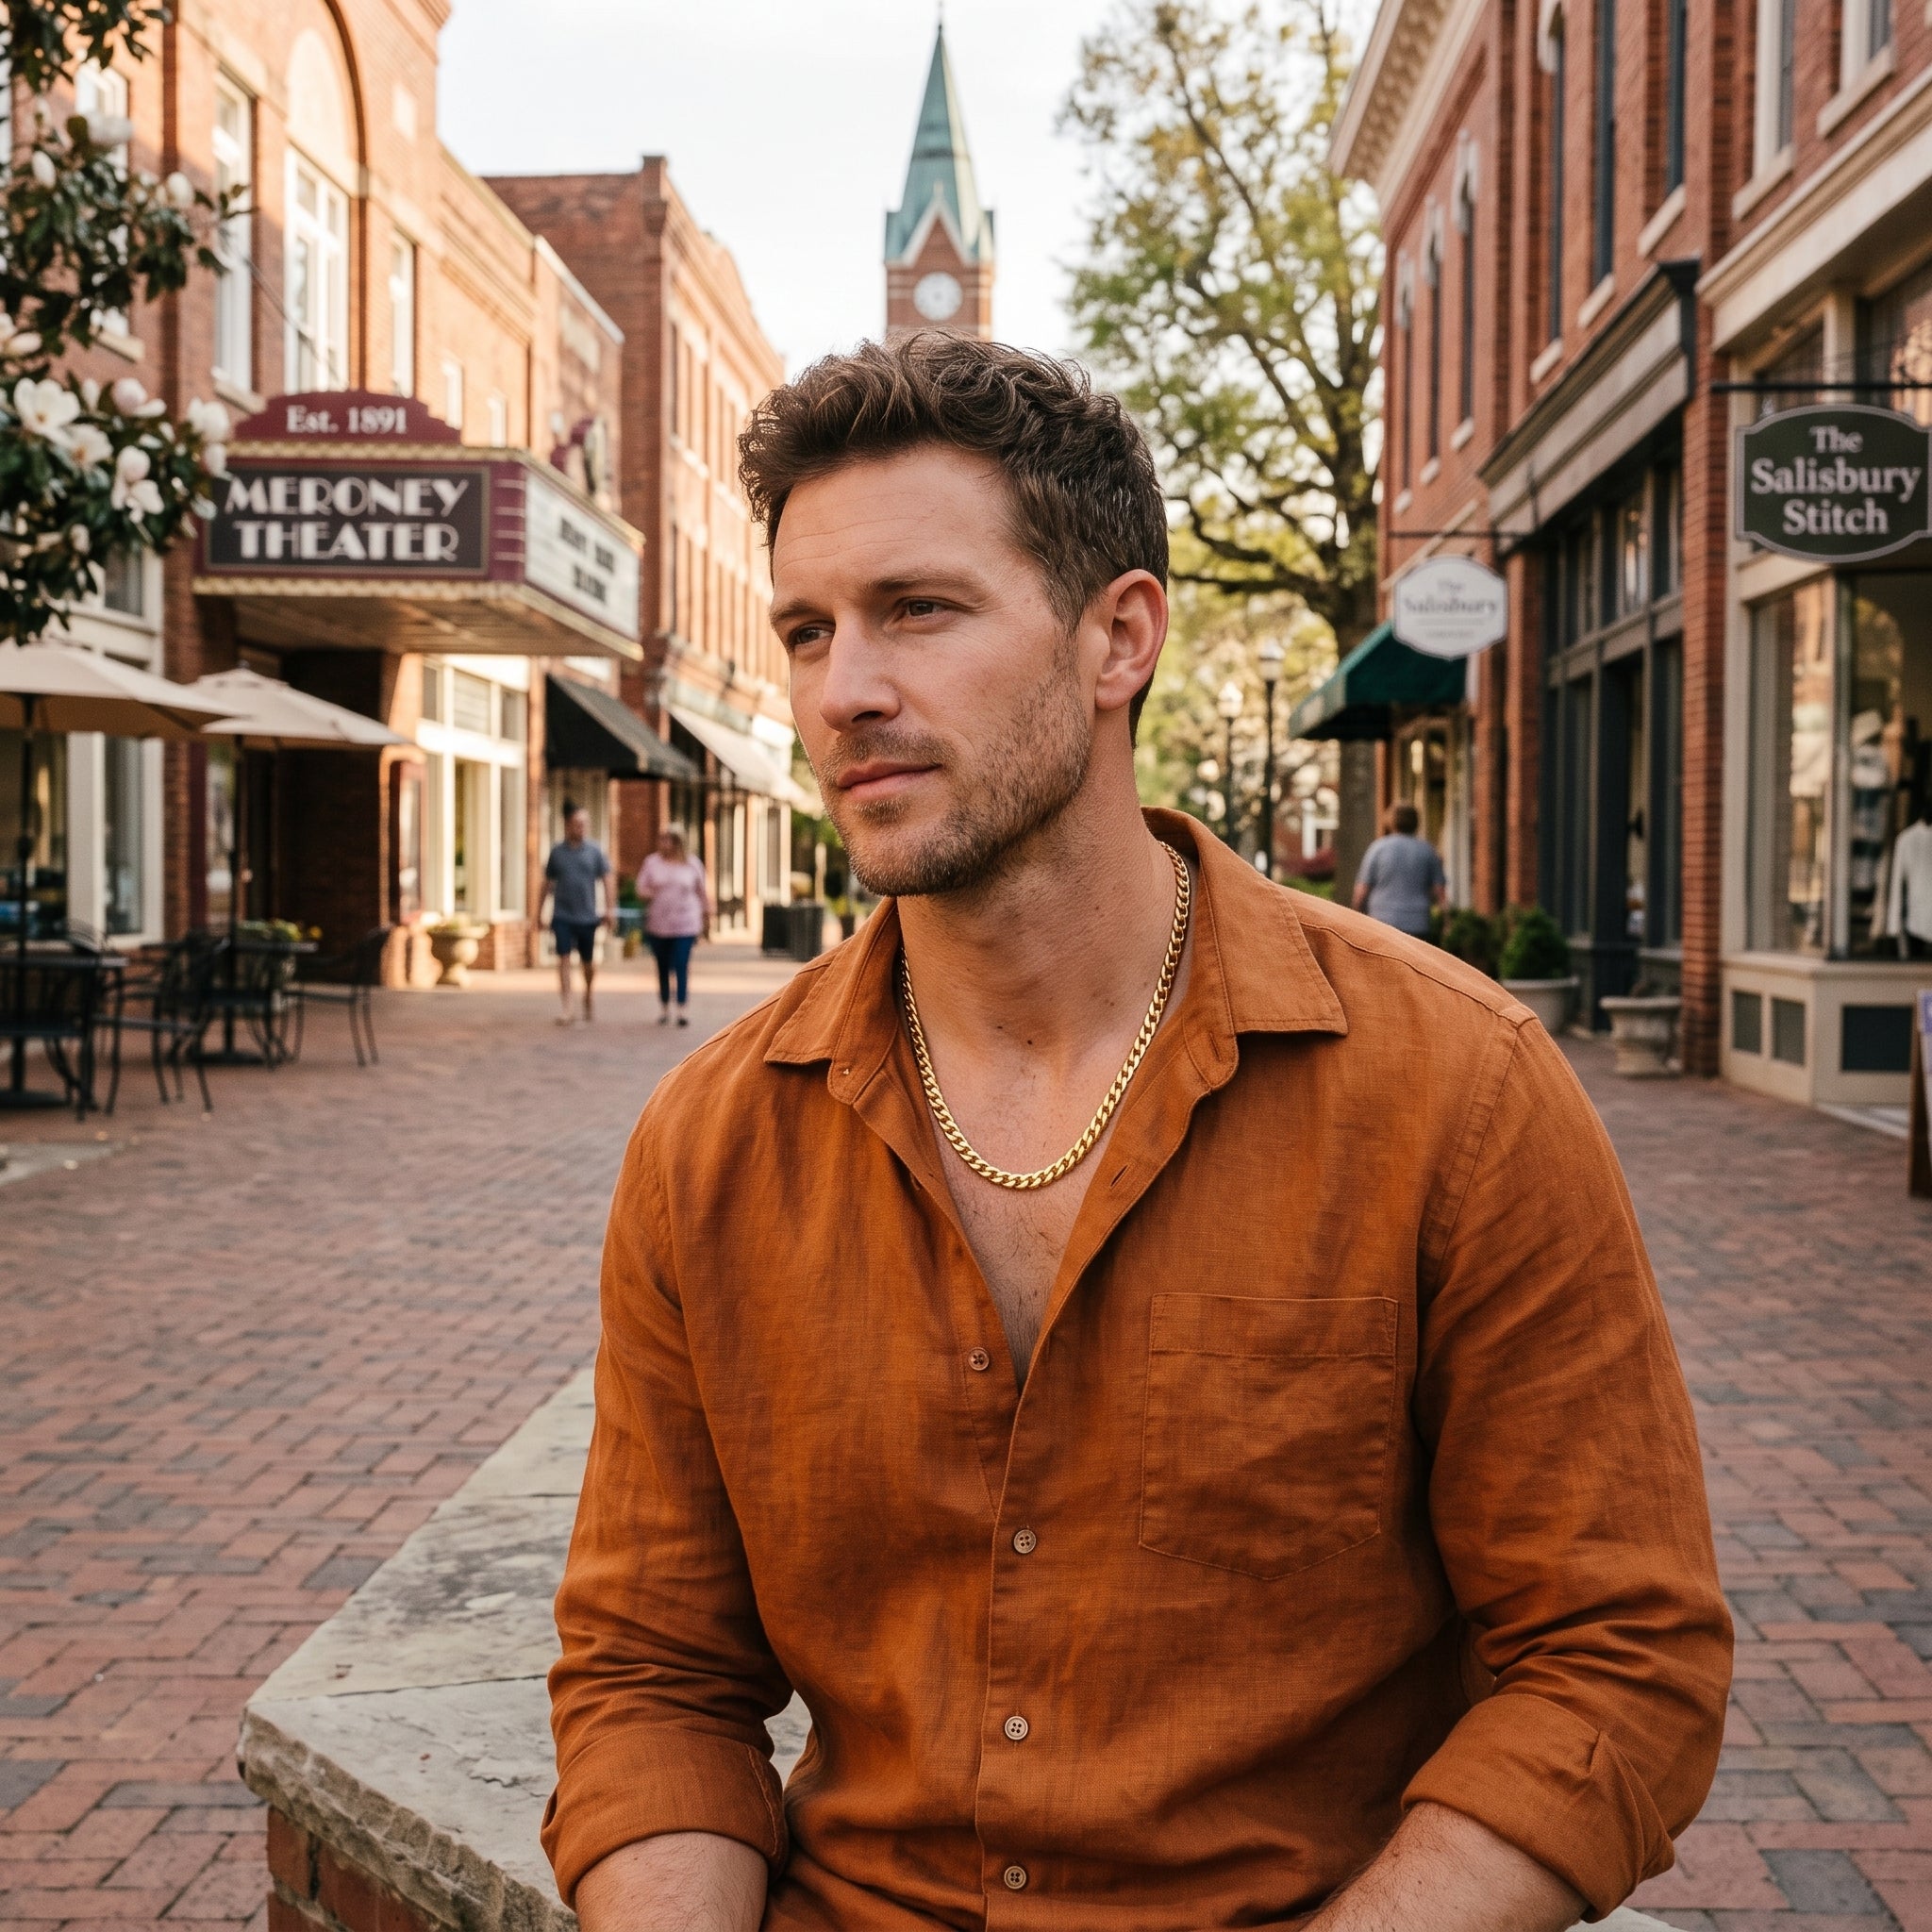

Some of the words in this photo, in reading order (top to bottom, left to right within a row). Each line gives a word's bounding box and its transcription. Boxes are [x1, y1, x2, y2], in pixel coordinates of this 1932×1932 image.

[286, 405, 339, 434] Est.
[348, 406, 407, 435] 1891
[1808, 425, 1863, 454] The
[225, 475, 469, 518] MERONEY
[1750, 456, 1922, 504] Salisbury
[1782, 496, 1889, 536] Stitch
[233, 520, 459, 562] THEATER
